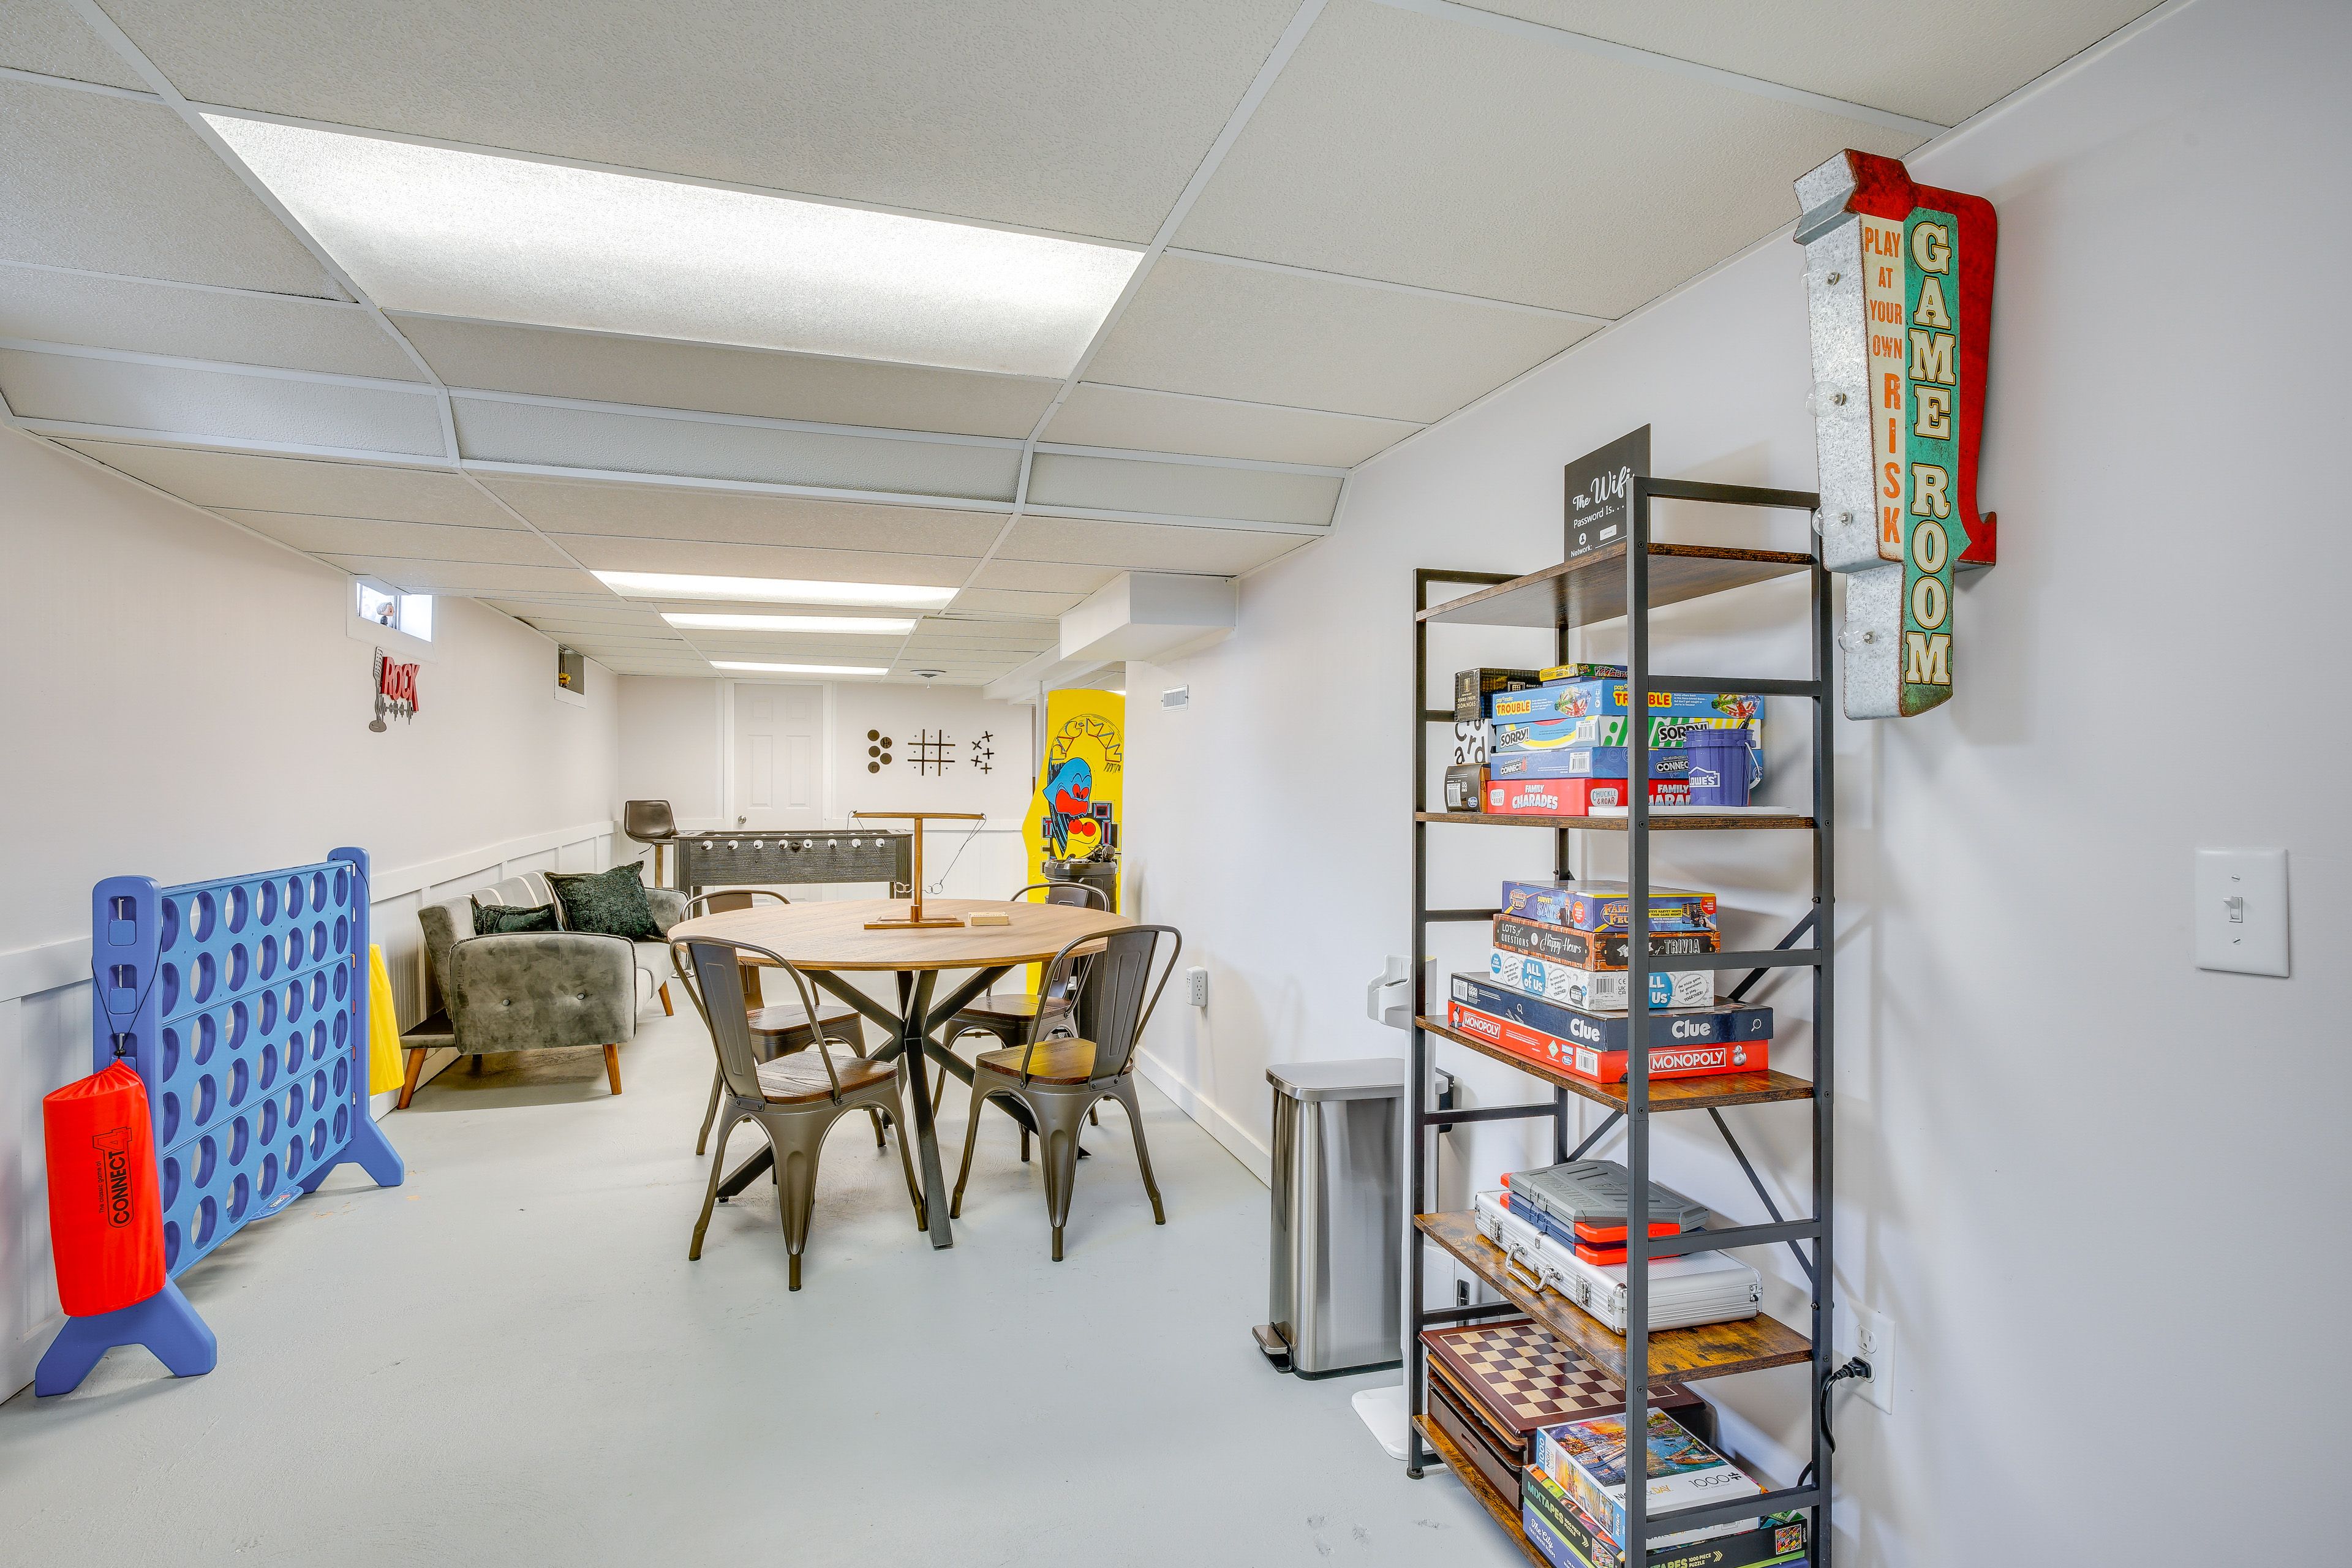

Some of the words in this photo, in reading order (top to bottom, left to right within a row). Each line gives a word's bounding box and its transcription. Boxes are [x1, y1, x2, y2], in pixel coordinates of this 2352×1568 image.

[1865, 227, 1901, 258] PLAY
[1879, 266, 1893, 289] AT
[1870, 300, 1902, 325] YOUR
[1909, 222, 1956, 440] GAME
[1873, 335, 1902, 360] OWN
[1883, 372, 1901, 544] RISK
[1572, 494, 1591, 511] The
[1574, 508, 1604, 529] Password
[1570, 544, 1593, 558] Network:
[1905, 462, 1951, 685] ROOM
[380, 657, 420, 711] ROCK
[1496, 701, 1531, 715] TROUBLE
[1501, 727, 1529, 747] SORRY!
[1501, 763, 1521, 775] CONNECT
[1521, 757, 1528, 772] 4
[1656, 761, 1689, 772] CONNEC
[1525, 785, 1545, 793] FAMILY
[1593, 790, 1616, 801] CHUCKLE
[1657, 785, 1689, 793] FAMILY
[1512, 794, 1559, 810] CHARADES
[1537, 902, 1561, 919] SAYS
[1604, 903, 1629, 916] FAMI
[1609, 913, 1629, 925] FEU
[1502, 924, 1516, 934] LOTS
[1516, 927, 1523, 936] of
[1501, 934, 1529, 947] QUESTIONS
[1540, 933, 1562, 954] Happy
[1562, 938, 1581, 953] Hours
[1664, 939, 1700, 954] TRIVIA
[1526, 963, 1541, 977] ALL
[1524, 975, 1532, 989] of
[1649, 976, 1665, 988] LL
[1685, 981, 1702, 992] generations
[1684, 990, 1703, 1002] TOGETHER!
[1464, 1016, 1499, 1036] MONOPOLY
[1570, 1018, 1600, 1042] Clue
[1672, 1019, 1711, 1038] Clue
[1652, 1051, 1724, 1069] MONOPOLY
[96, 1129, 130, 1151] 4
[108, 1151, 130, 1224] CONNECT
[1688, 1474, 1730, 1488] 1000
[1527, 1480, 1564, 1525] MIXTAPES
[1531, 1518, 1542, 1535] The
[1542, 1529, 1553, 1548] City
